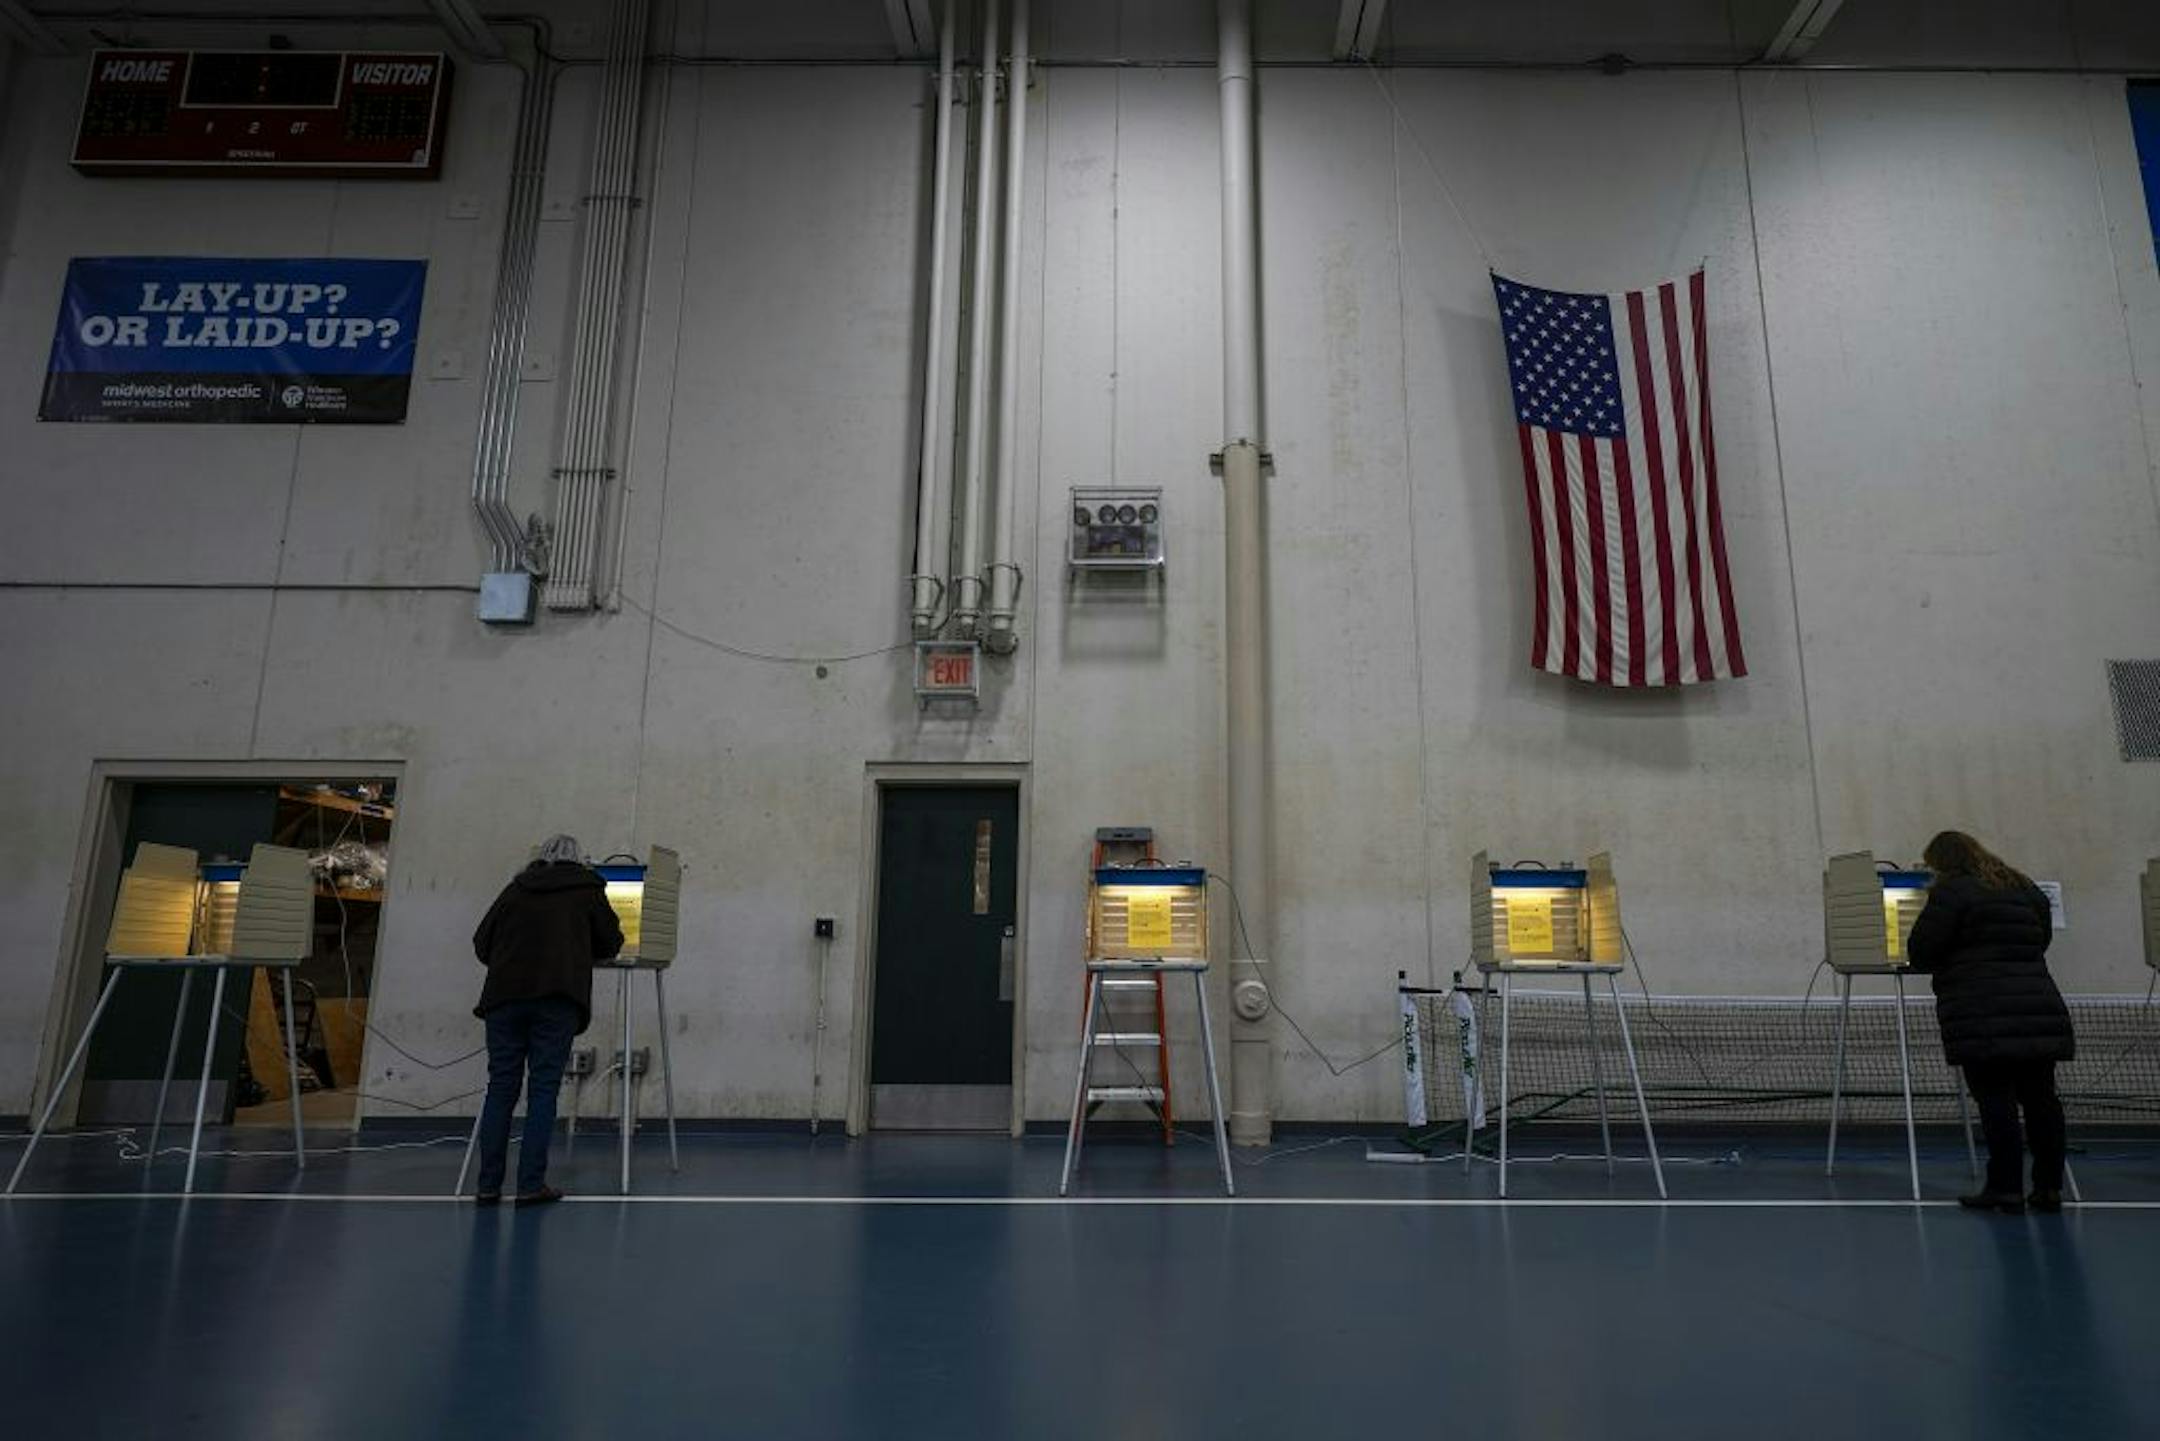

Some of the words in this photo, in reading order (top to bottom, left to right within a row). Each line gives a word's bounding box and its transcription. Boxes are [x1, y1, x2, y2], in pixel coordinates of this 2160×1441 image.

[99, 60, 173, 84] HOME
[351, 62, 434, 86] VISITOR
[248, 121, 261, 134] 2
[138, 282, 348, 314] LAY-UP?
[80, 315, 149, 348] OR
[163, 316, 401, 350] LAID-UP?
[103, 384, 173, 399] midwest
[174, 384, 262, 401] orthopedic
[934, 658, 968, 684] EXIT
